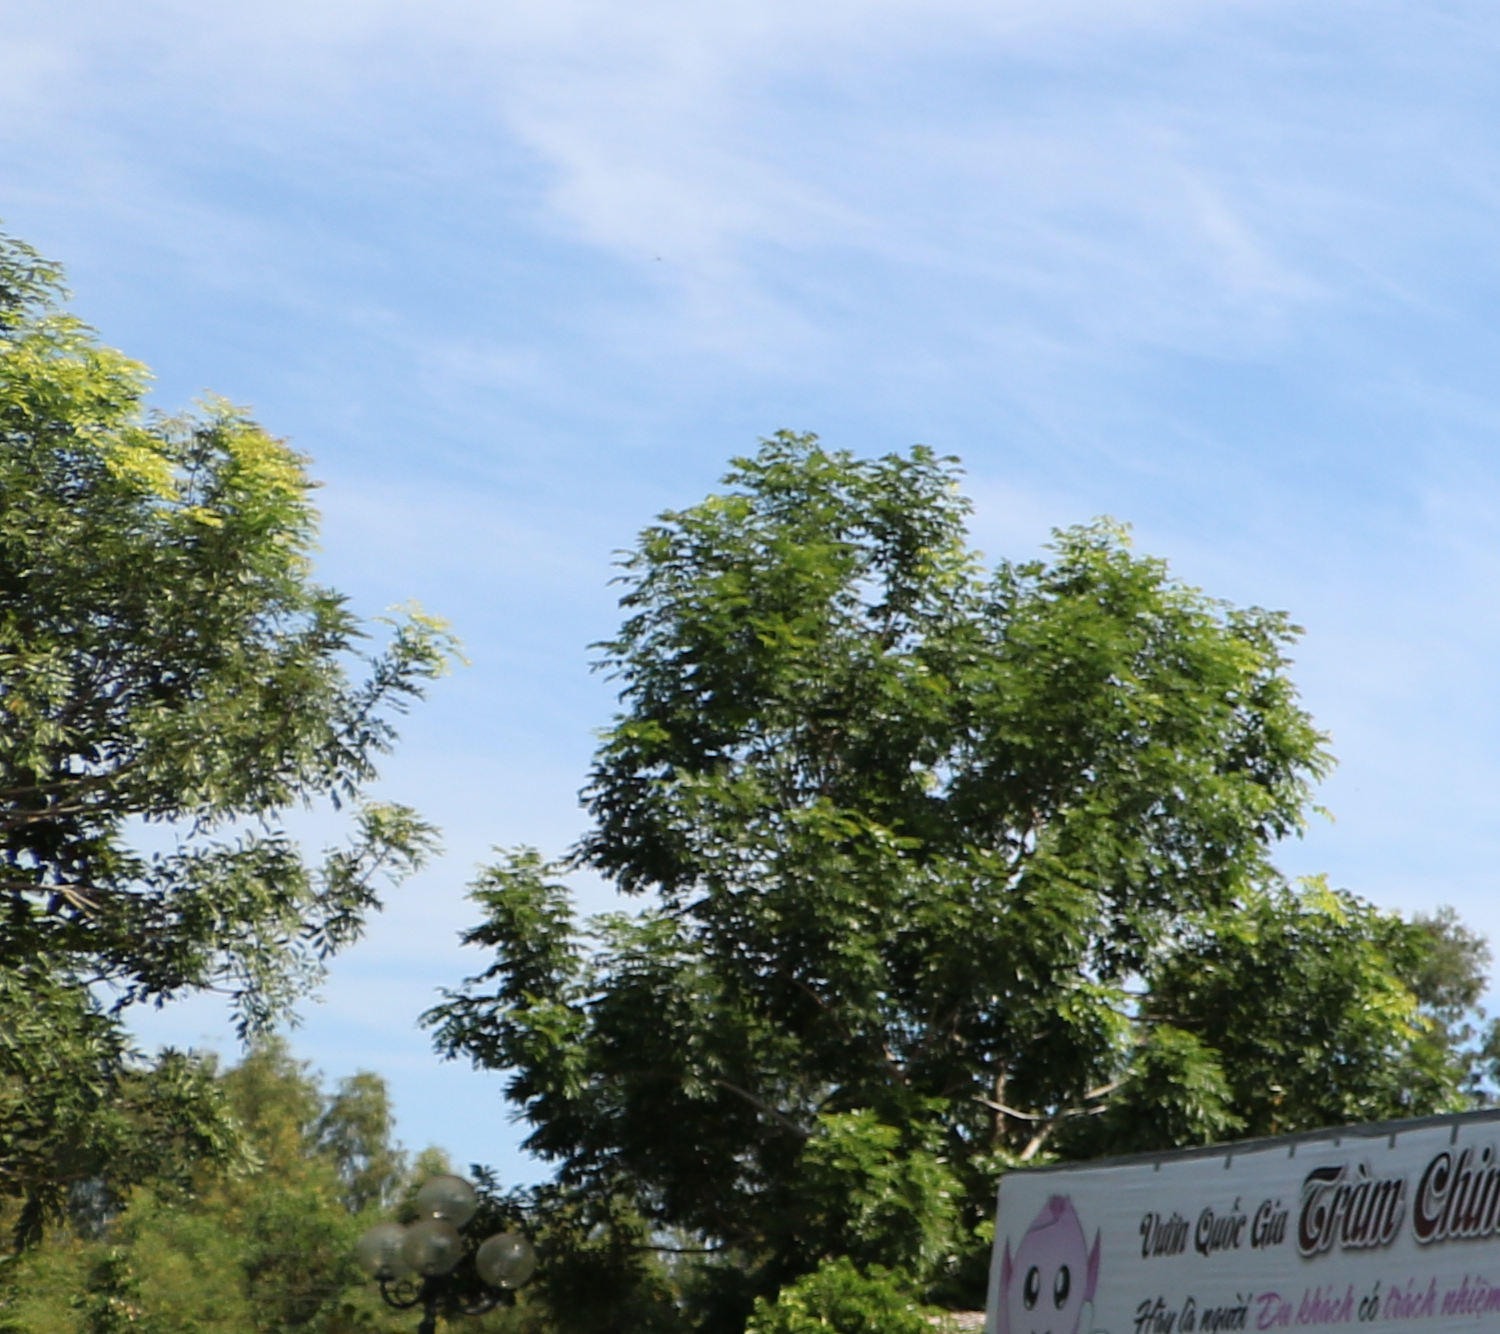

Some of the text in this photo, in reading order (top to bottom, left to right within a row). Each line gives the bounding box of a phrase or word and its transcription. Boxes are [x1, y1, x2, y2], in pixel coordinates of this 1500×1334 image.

[1195, 1197, 1248, 1258] Quốc
[1250, 1199, 1289, 1251] Gia
[1299, 1162, 1405, 1257] Tràm
[1256, 1290, 1289, 1331] Du
[1294, 1284, 1355, 1327] khách
[1359, 1281, 1380, 1323] có
